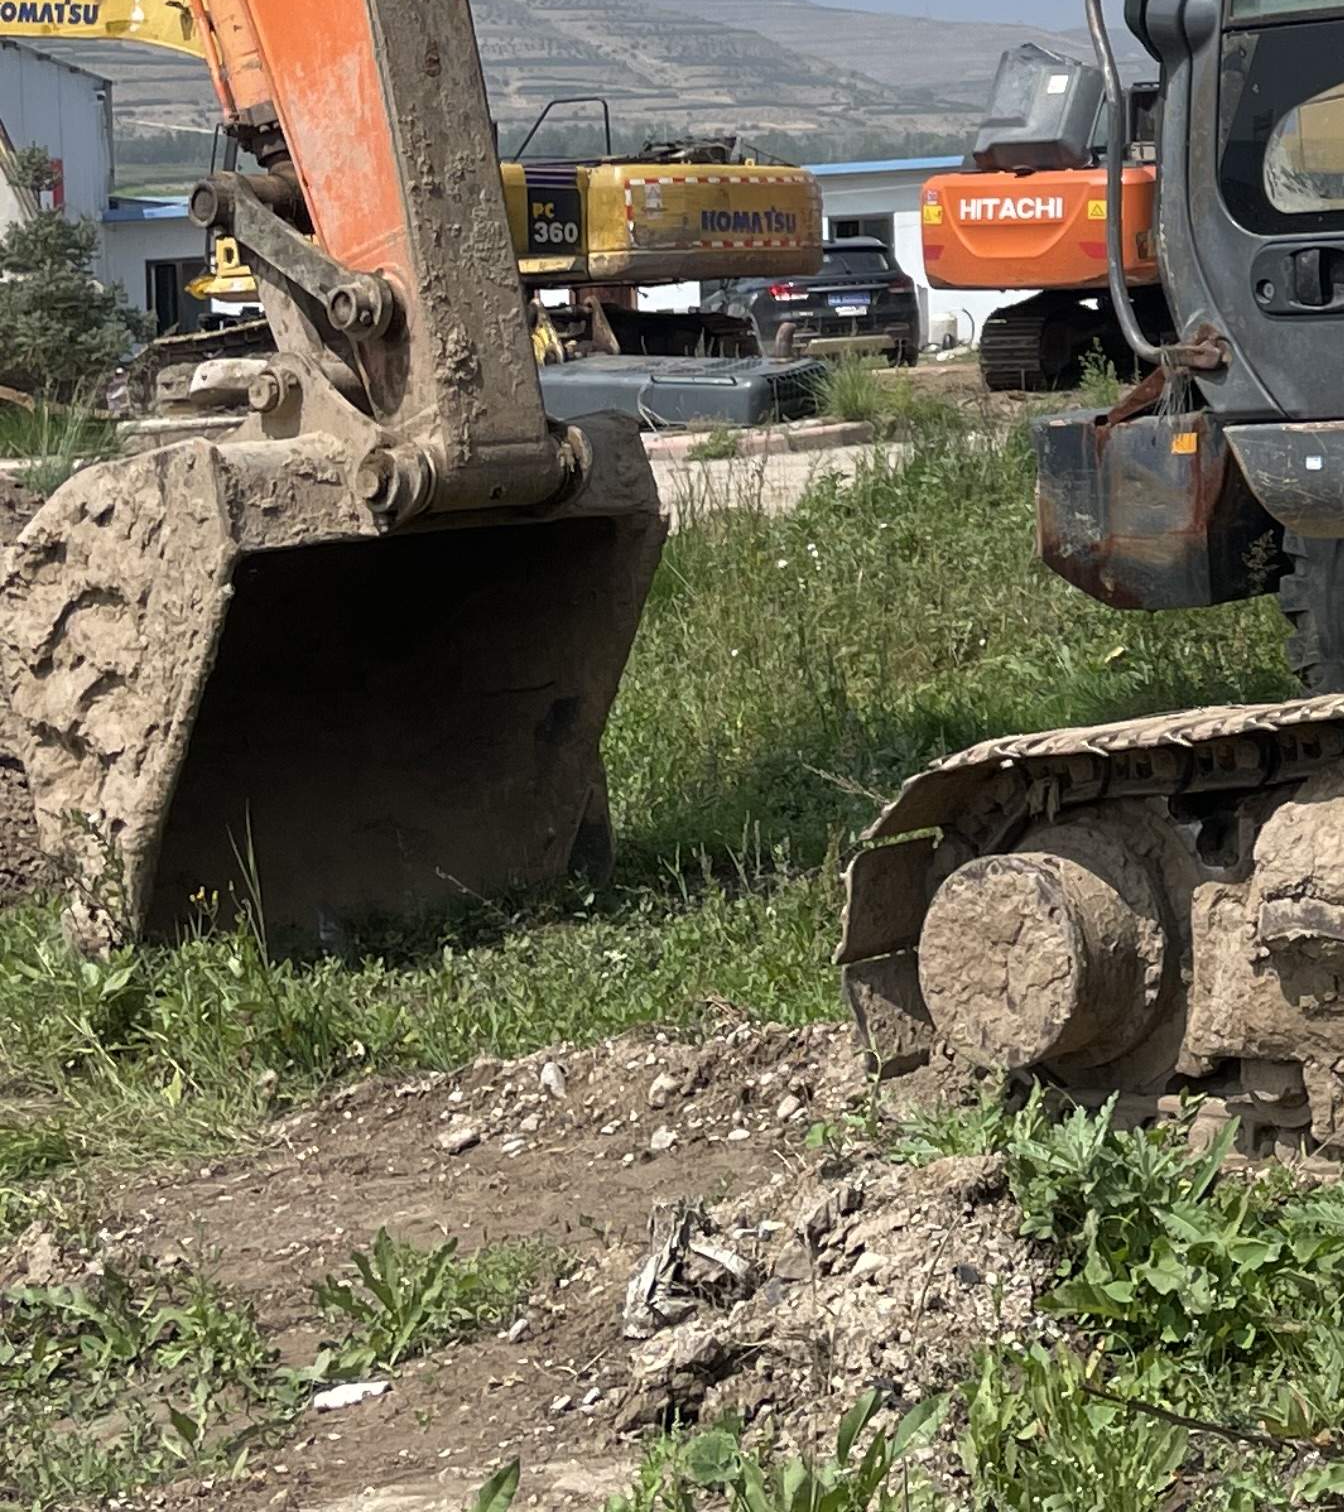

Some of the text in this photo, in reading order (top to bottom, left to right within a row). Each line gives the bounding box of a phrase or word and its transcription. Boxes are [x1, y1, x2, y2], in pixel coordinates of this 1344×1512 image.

[532, 202, 555, 219] PC
[701, 205, 797, 234] KOMATSU
[959, 197, 1063, 220] HITACHI
[533, 221, 579, 244] 360
